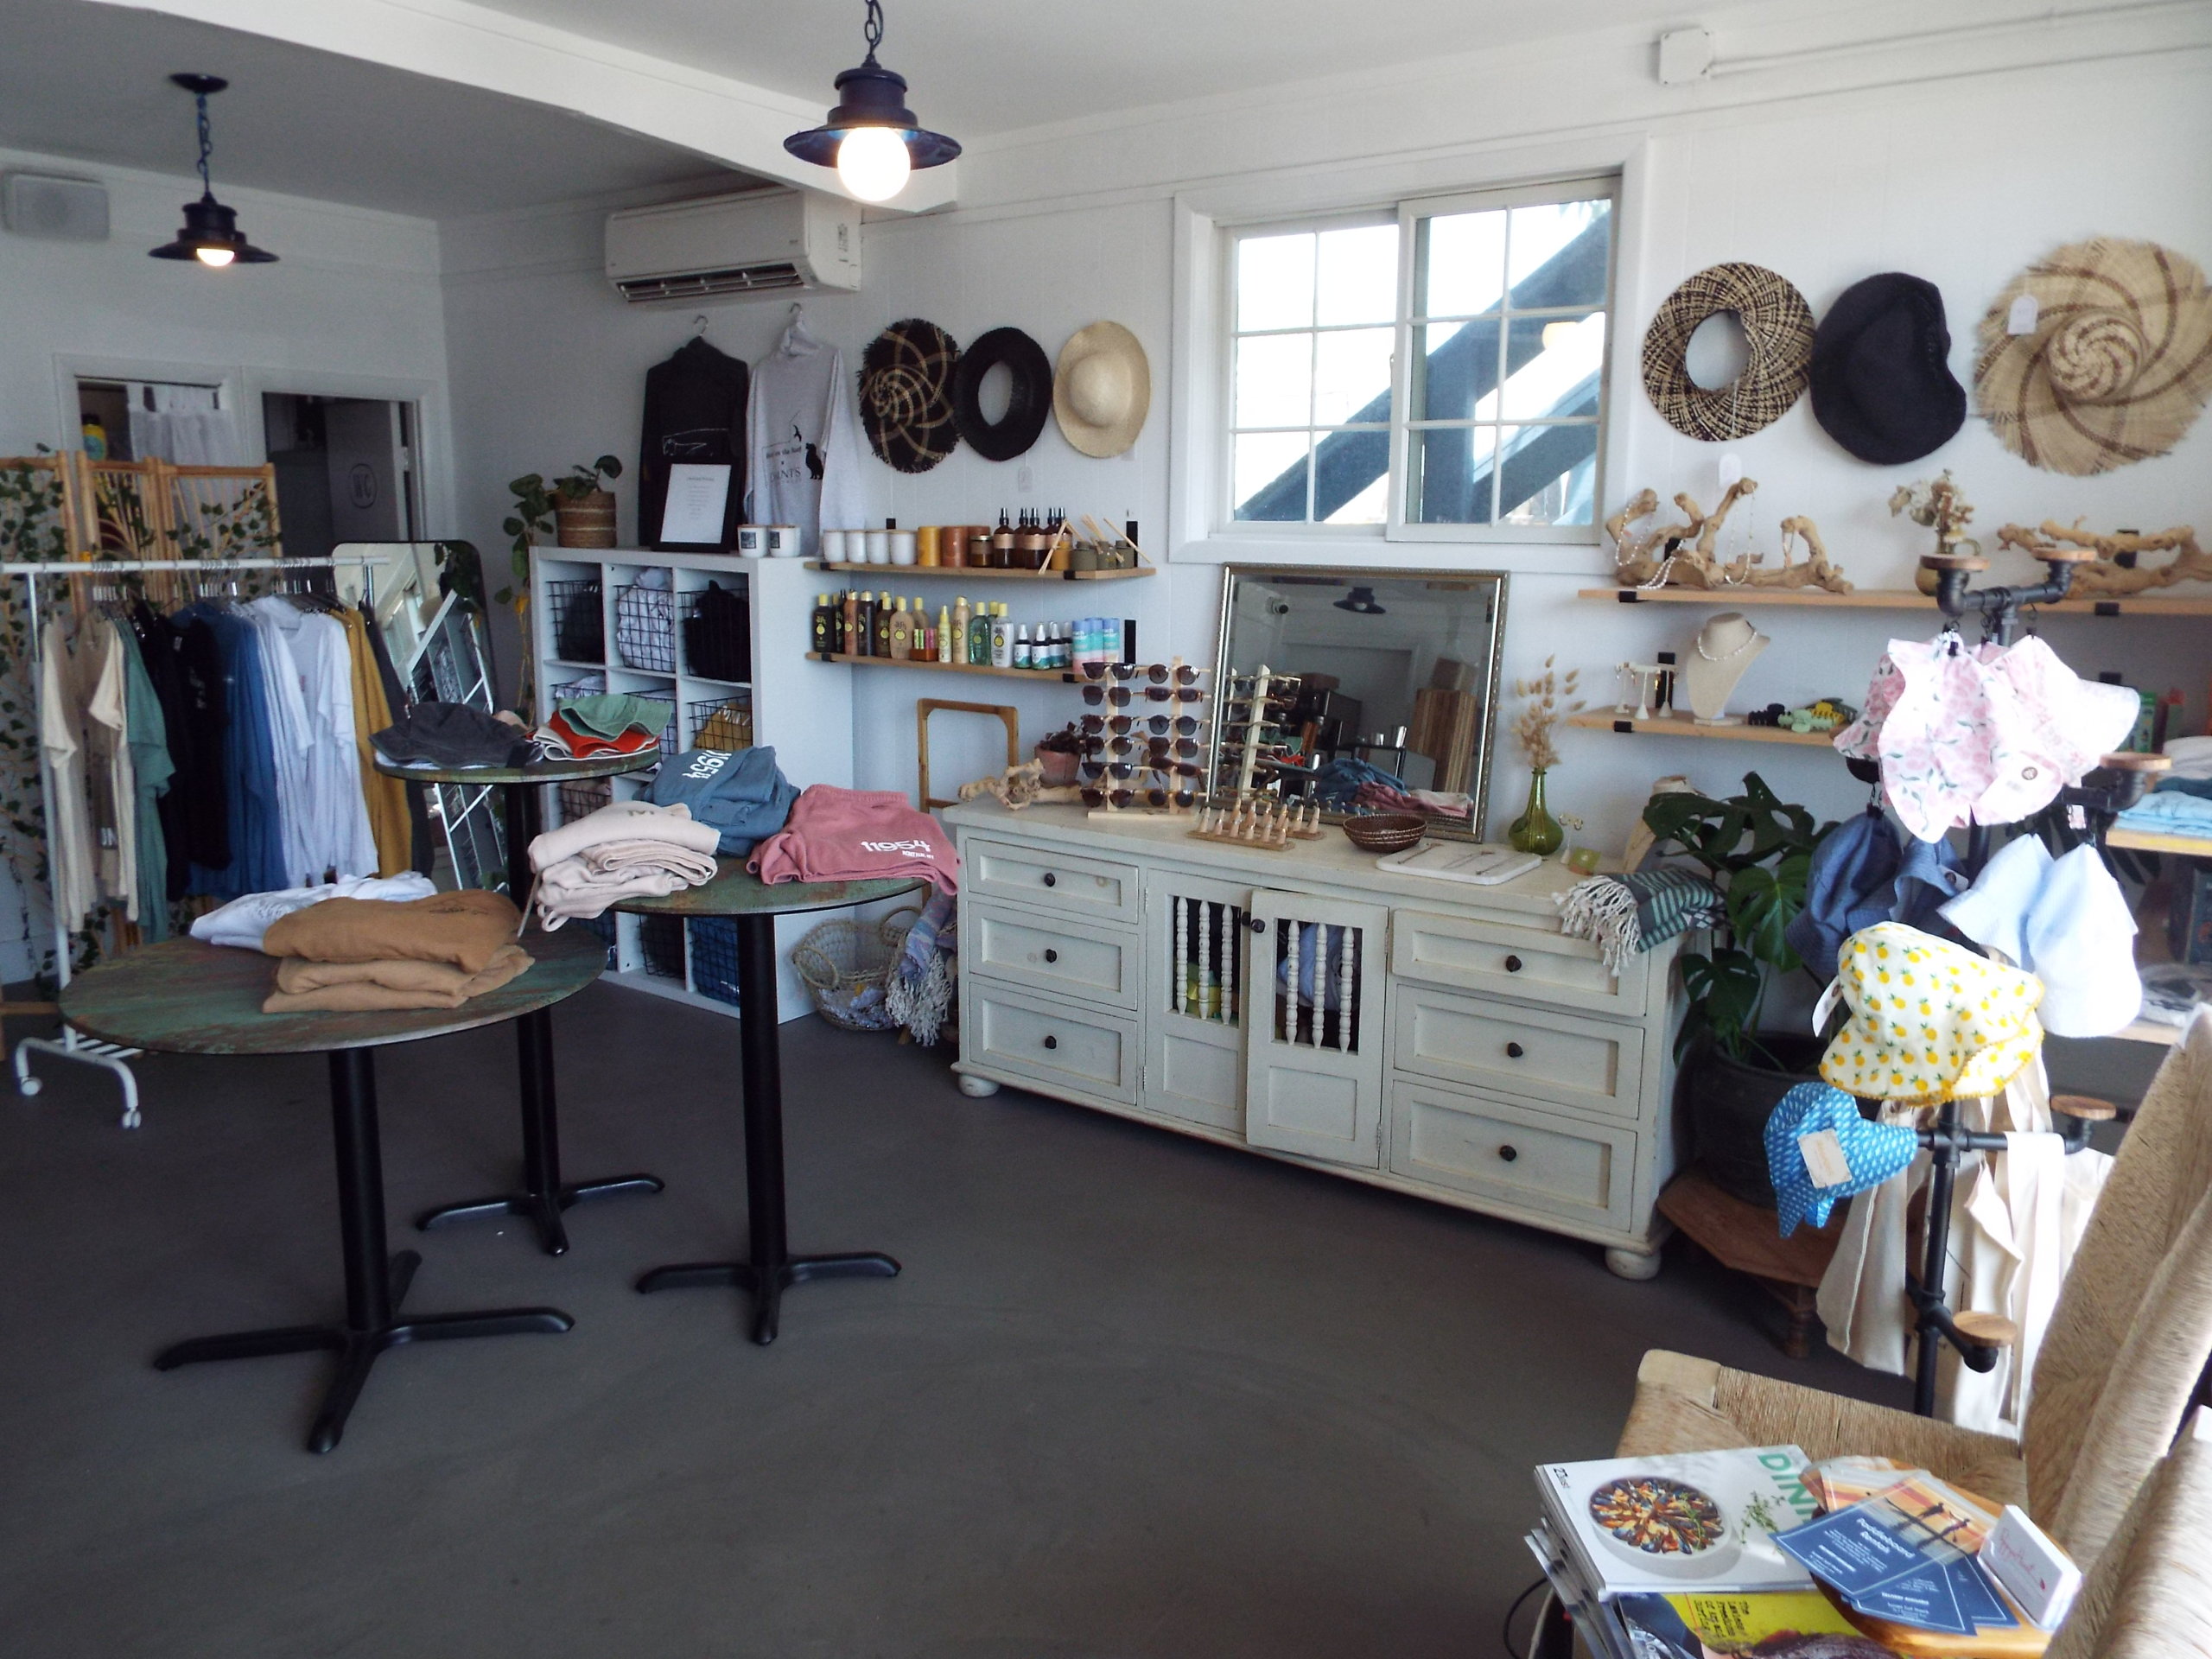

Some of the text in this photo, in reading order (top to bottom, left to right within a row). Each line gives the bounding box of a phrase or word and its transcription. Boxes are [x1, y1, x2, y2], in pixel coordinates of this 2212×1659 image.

[681, 749, 733, 779] 11954
[861, 839, 931, 853] 11954
[1758, 1452, 1817, 1524] DINI
[1856, 1516, 1916, 1559] Paddleboard
